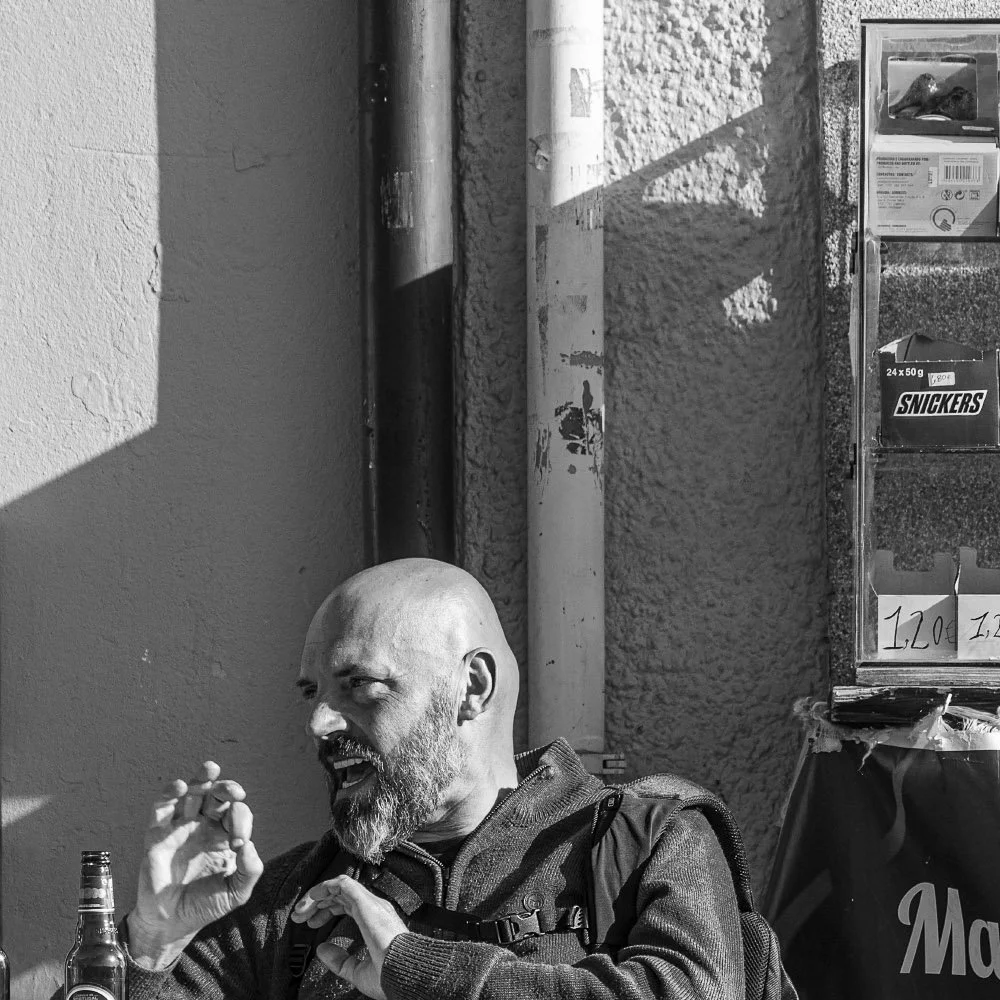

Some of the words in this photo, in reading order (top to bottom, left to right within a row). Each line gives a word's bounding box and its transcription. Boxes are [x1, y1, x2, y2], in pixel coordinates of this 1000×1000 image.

[886, 368, 897, 377] 24
[905, 367, 917, 377] 50
[896, 392, 985, 415] SNICKERS
